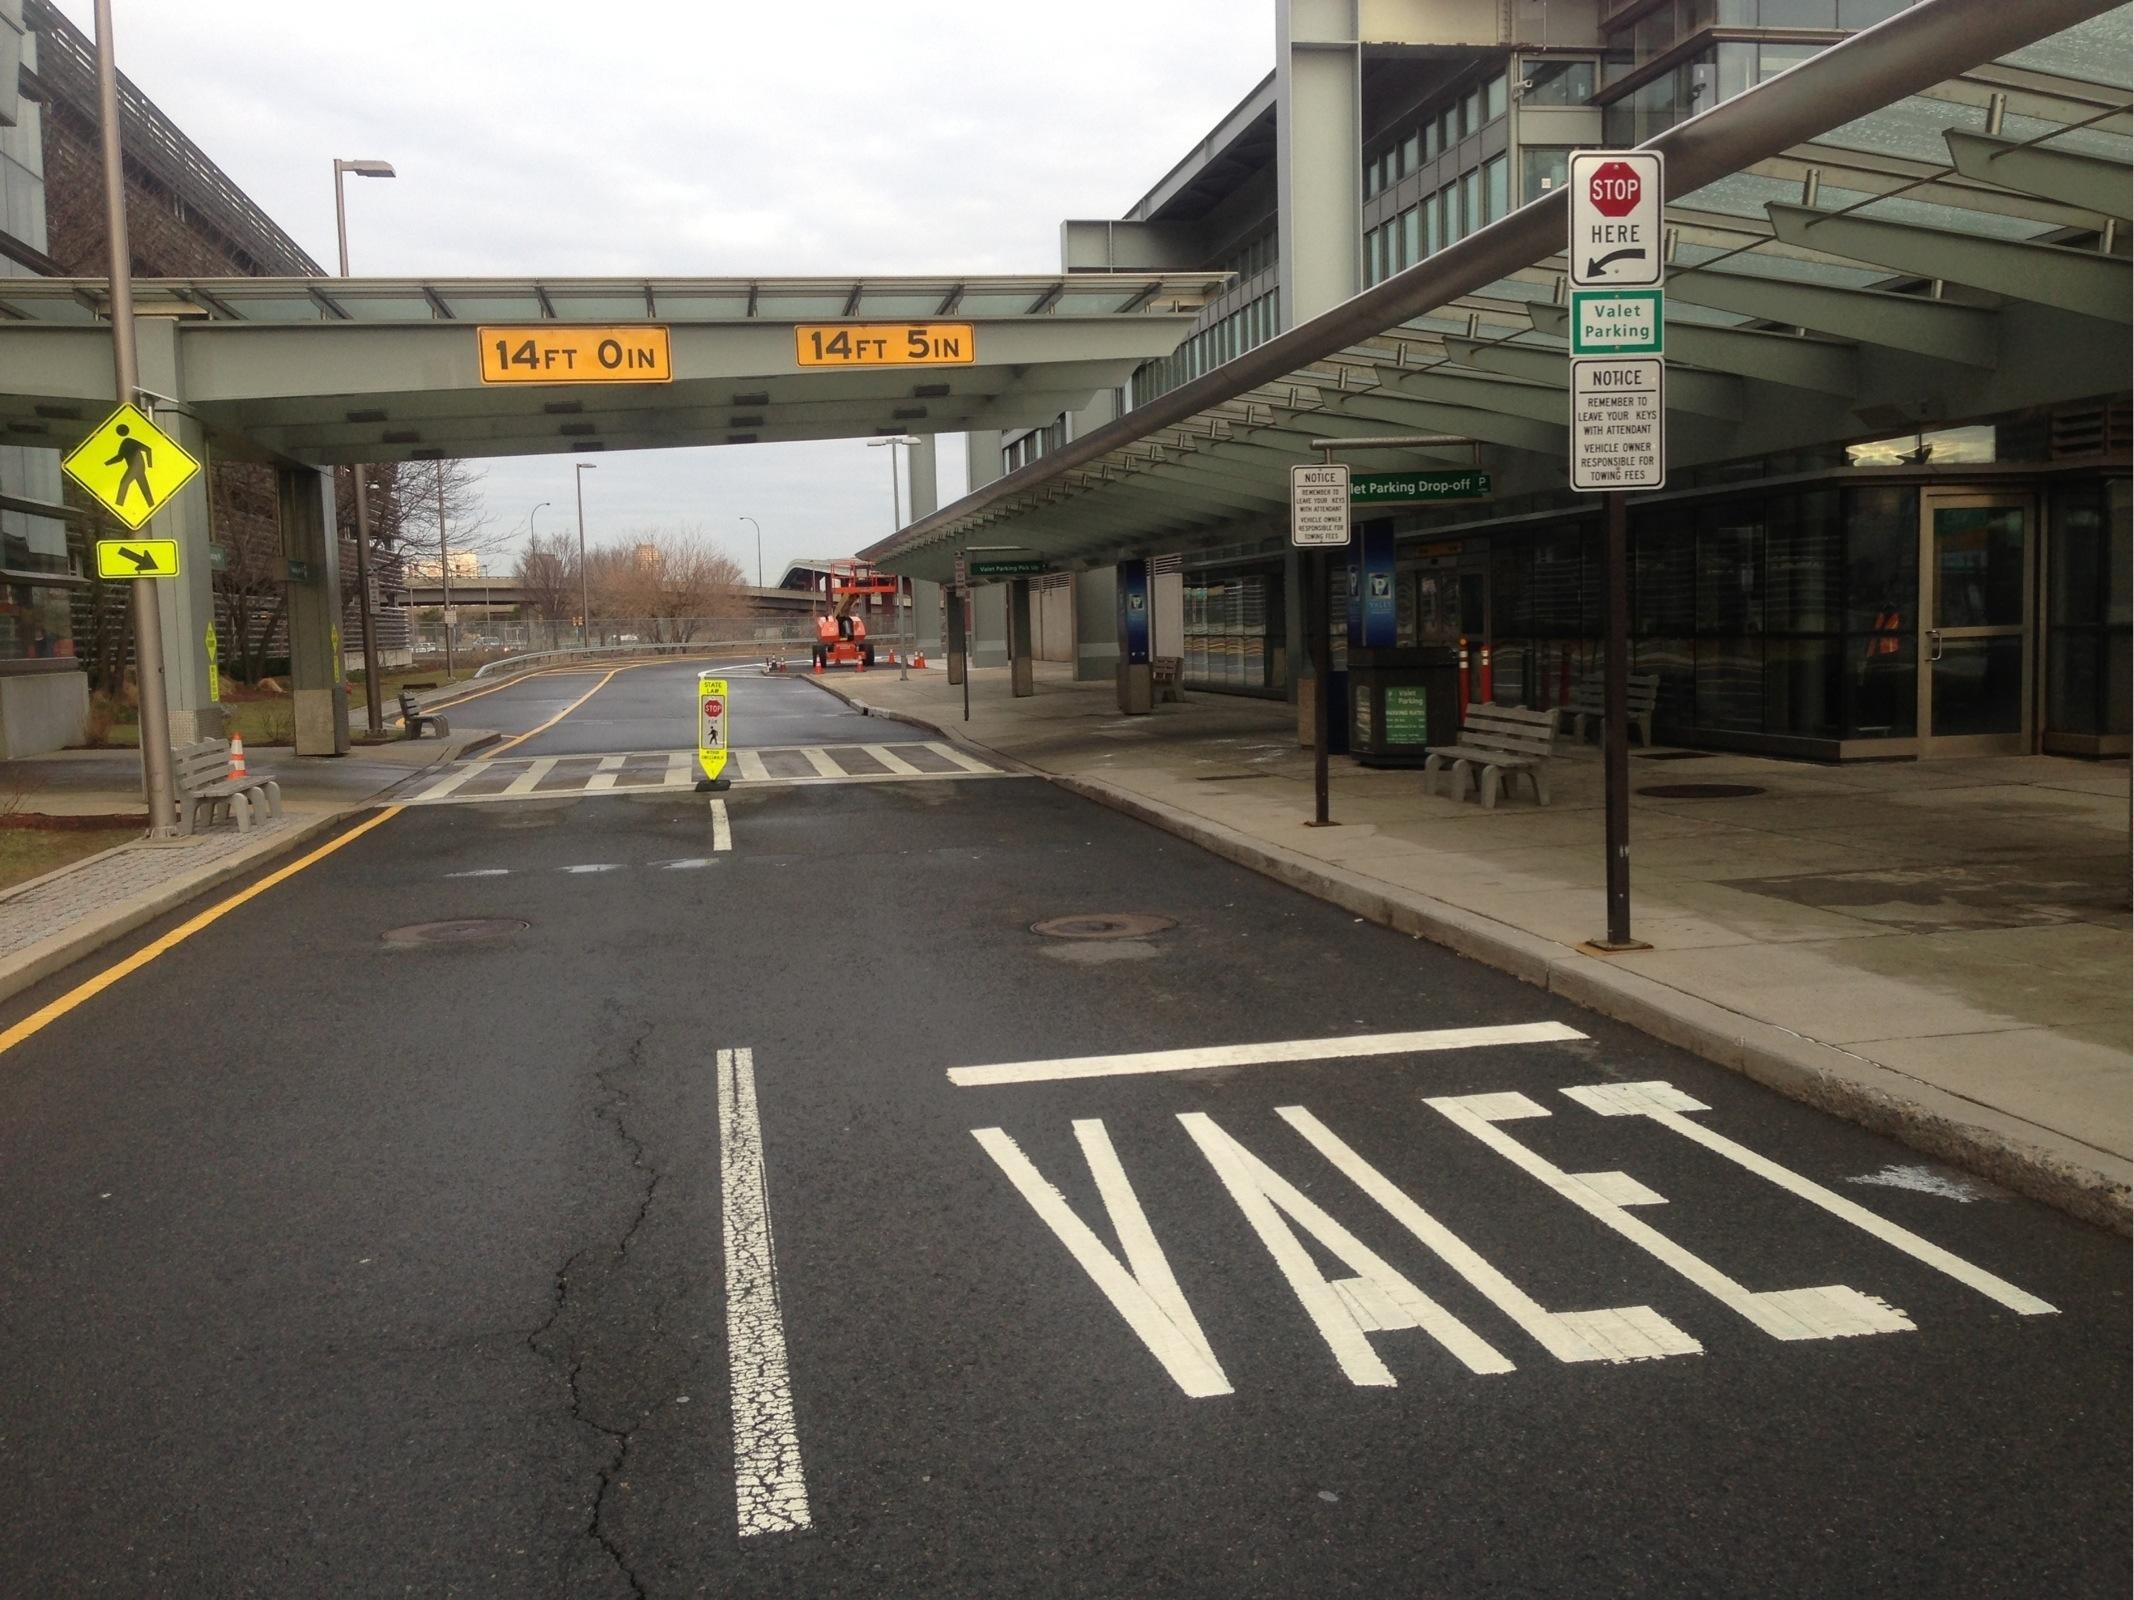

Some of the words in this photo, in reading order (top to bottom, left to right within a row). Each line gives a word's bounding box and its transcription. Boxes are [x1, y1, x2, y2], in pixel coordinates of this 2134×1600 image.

[1592, 179, 1638, 200] STOP
[1592, 225, 1640, 243] HERE
[1594, 304, 1641, 318] Valet
[1585, 324, 1650, 340] Parking
[1593, 370, 1642, 386] NOTICE
[1588, 397, 1634, 407] REMEMBER
[1638, 396, 1647, 406] TO
[1578, 411, 1603, 421] LEAVE
[1607, 411, 1629, 421] YOUR
[1636, 410, 1656, 420] KEYS
[1584, 426, 1603, 435] WITH
[1607, 424, 1651, 435] ATTENDANT
[1584, 443, 1620, 453] VEHICLE
[1622, 442, 1651, 452] OWNER
[1581, 456, 1635, 467] RESPONSIBLE
[1640, 456, 1654, 466] FOR
[1305, 472, 1336, 482] NOTICE
[1591, 471, 1622, 480] TOWING
[1624, 470, 1646, 480] FEES
[1350, 483, 1366, 494] let
[1369, 481, 1416, 495] Parking
[1418, 478, 1471, 493] Drop-off
[1398, 697, 1423, 706] Parking
[705, 704, 722, 712] STOP
[972, 1081, 2061, 1398] VALET
